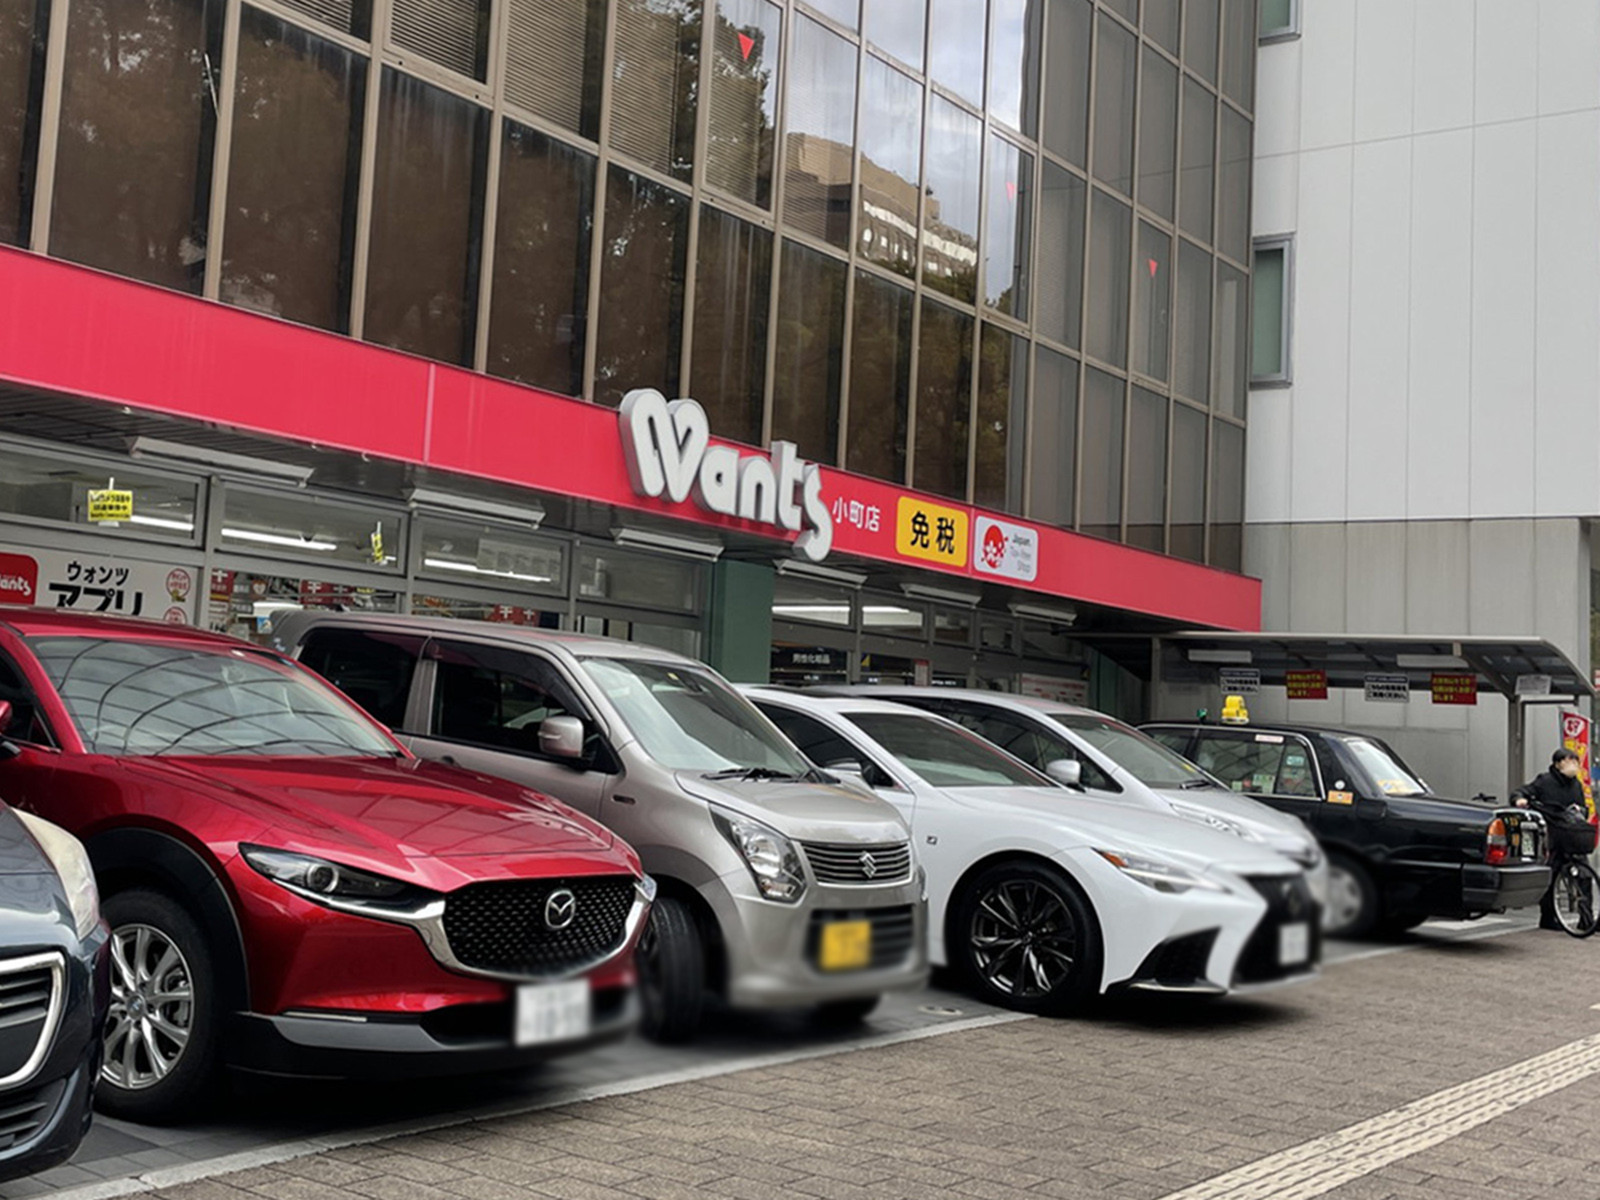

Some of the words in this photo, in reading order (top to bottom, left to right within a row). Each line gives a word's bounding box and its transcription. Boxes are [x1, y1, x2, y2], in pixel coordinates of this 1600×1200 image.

[619, 388, 833, 562] Wants
[832, 496, 881, 533] 小町店
[909, 510, 956, 555] 免税
[0, 573, 32, 597] ants
[66, 560, 130, 587] ウォンツ
[48, 582, 144, 616] アプリ
